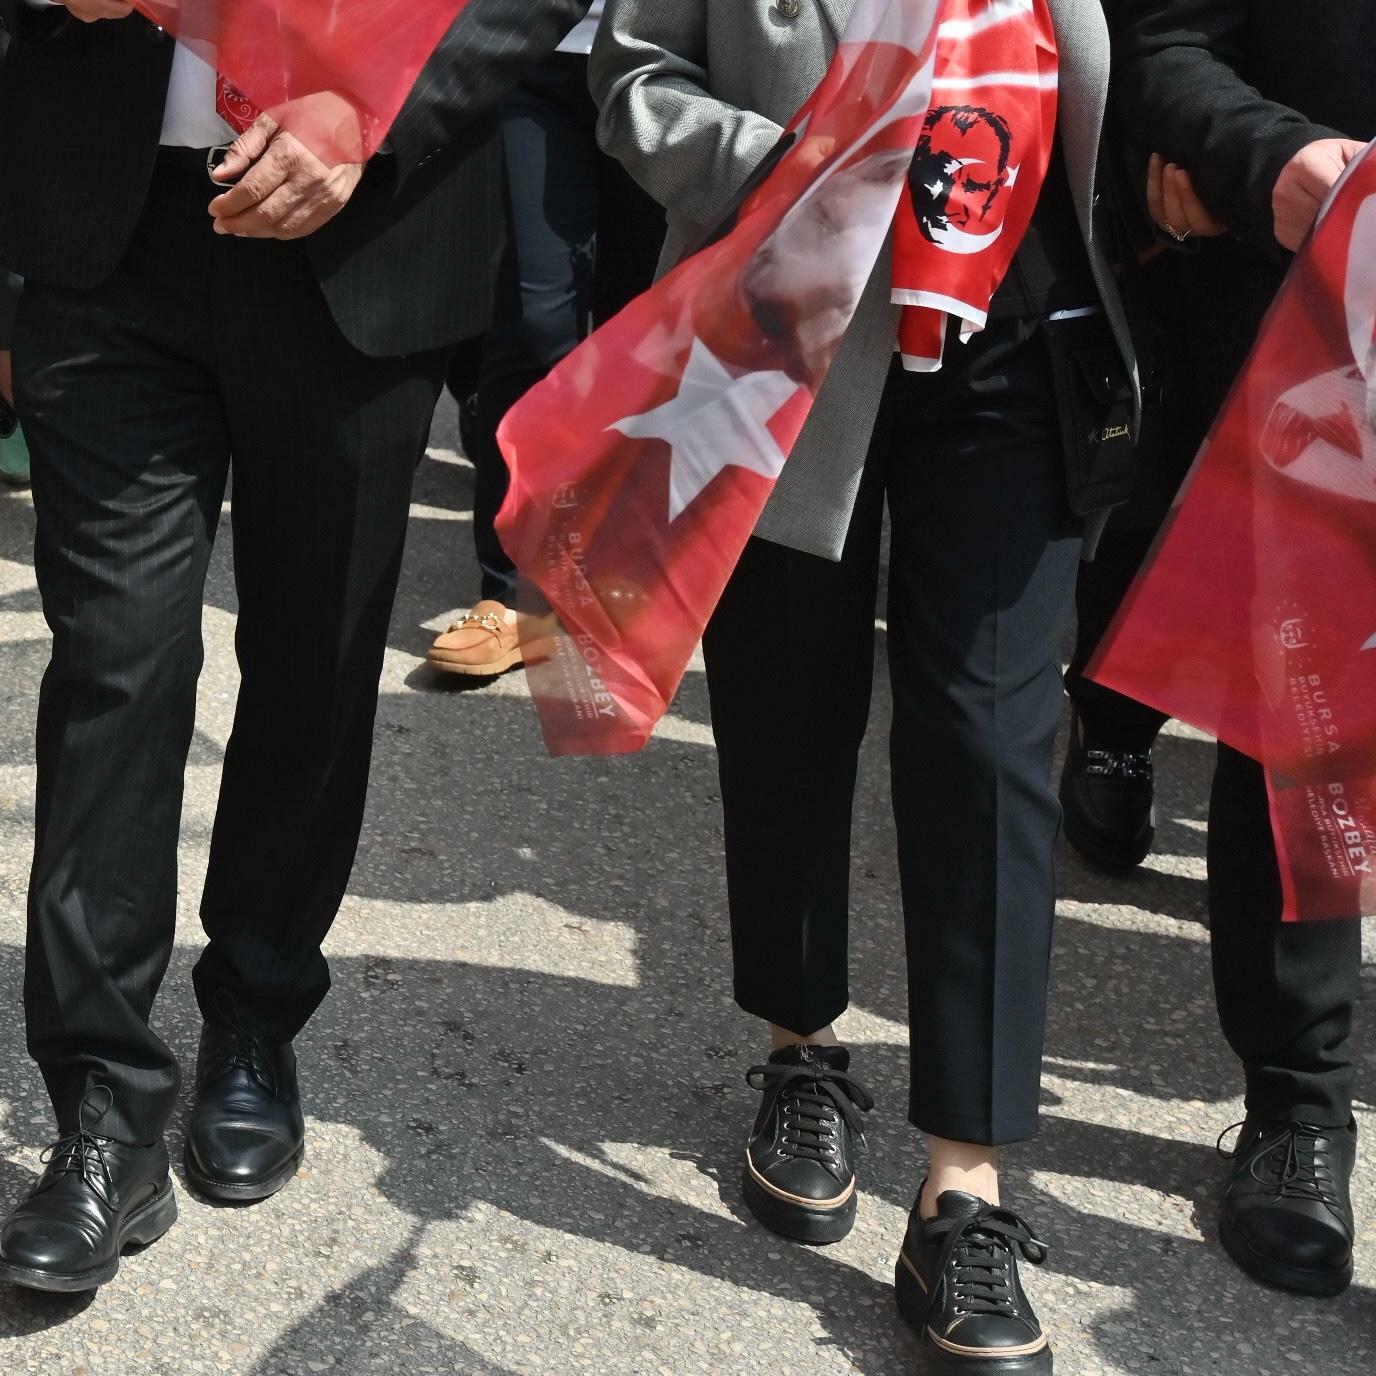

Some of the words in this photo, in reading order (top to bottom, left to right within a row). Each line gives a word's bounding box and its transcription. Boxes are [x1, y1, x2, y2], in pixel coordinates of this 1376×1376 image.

[568, 531, 594, 607] BURSA
[577, 632, 616, 717] BOZBEY
[1306, 672, 1342, 754] BURSA
[1327, 781, 1373, 873] BOZBEY
